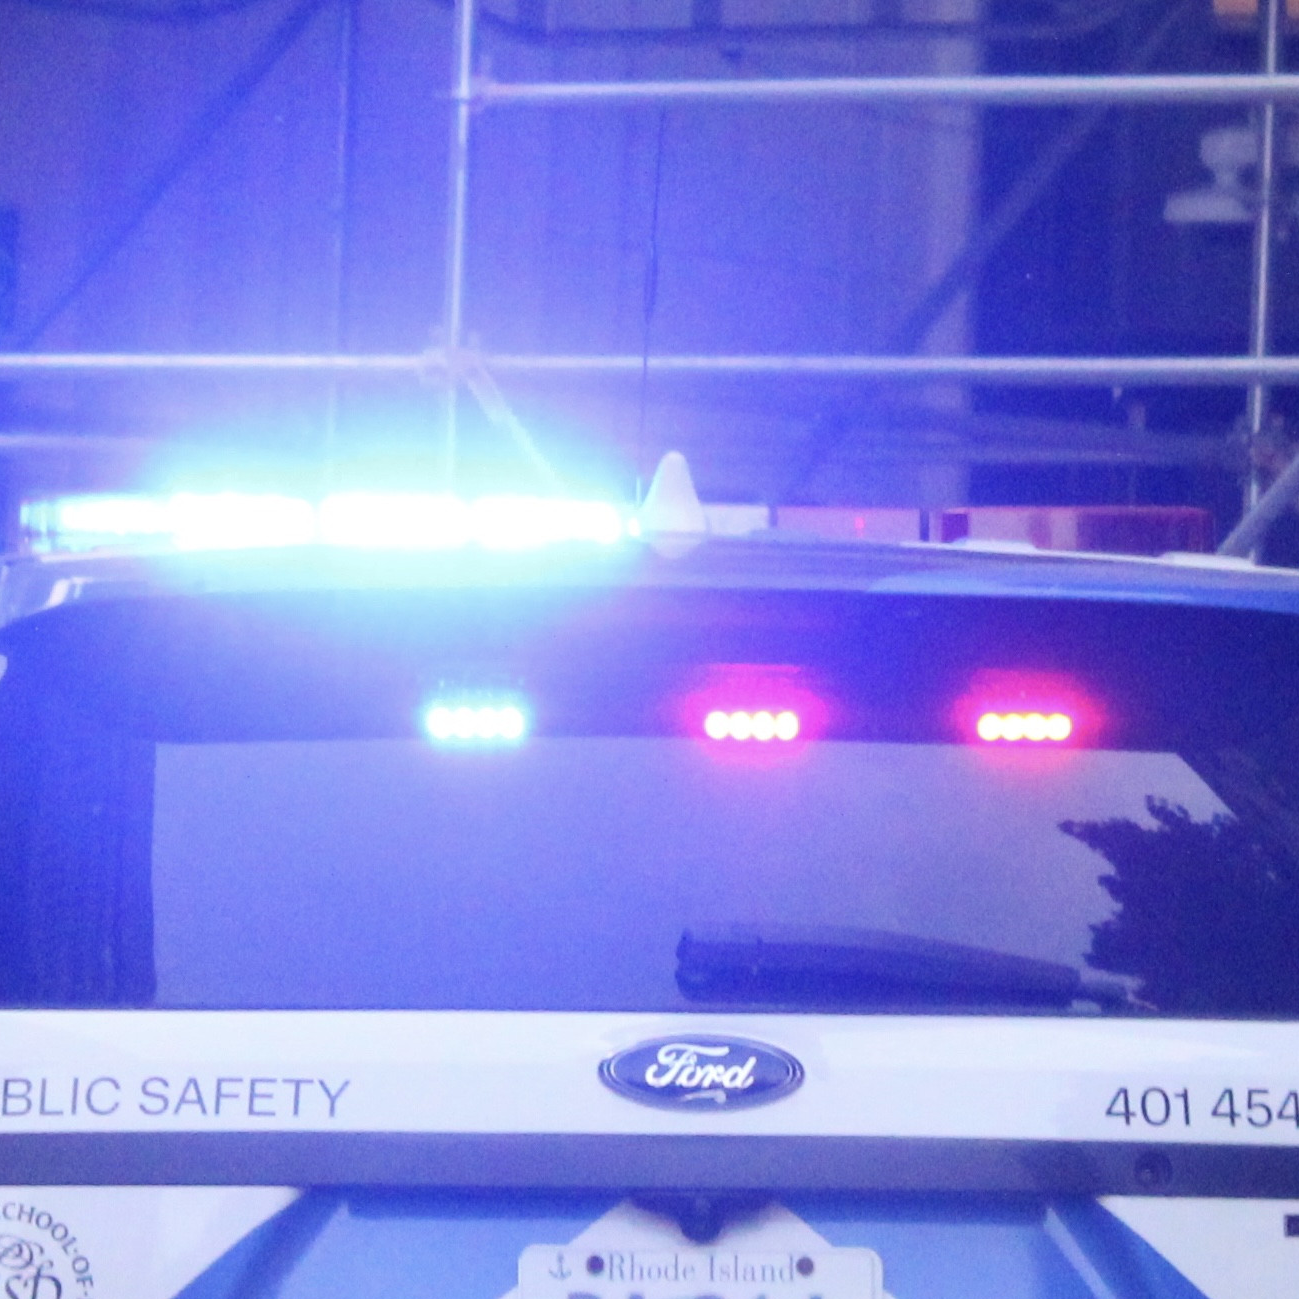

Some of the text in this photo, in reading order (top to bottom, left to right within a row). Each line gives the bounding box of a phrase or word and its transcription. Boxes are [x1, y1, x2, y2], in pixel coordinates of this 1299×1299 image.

[644, 1042, 758, 1089] Ford
[138, 1076, 351, 1118] SAFETY
[1104, 1086, 1192, 1127] 401
[608, 1253, 797, 1282] Rhode Island
